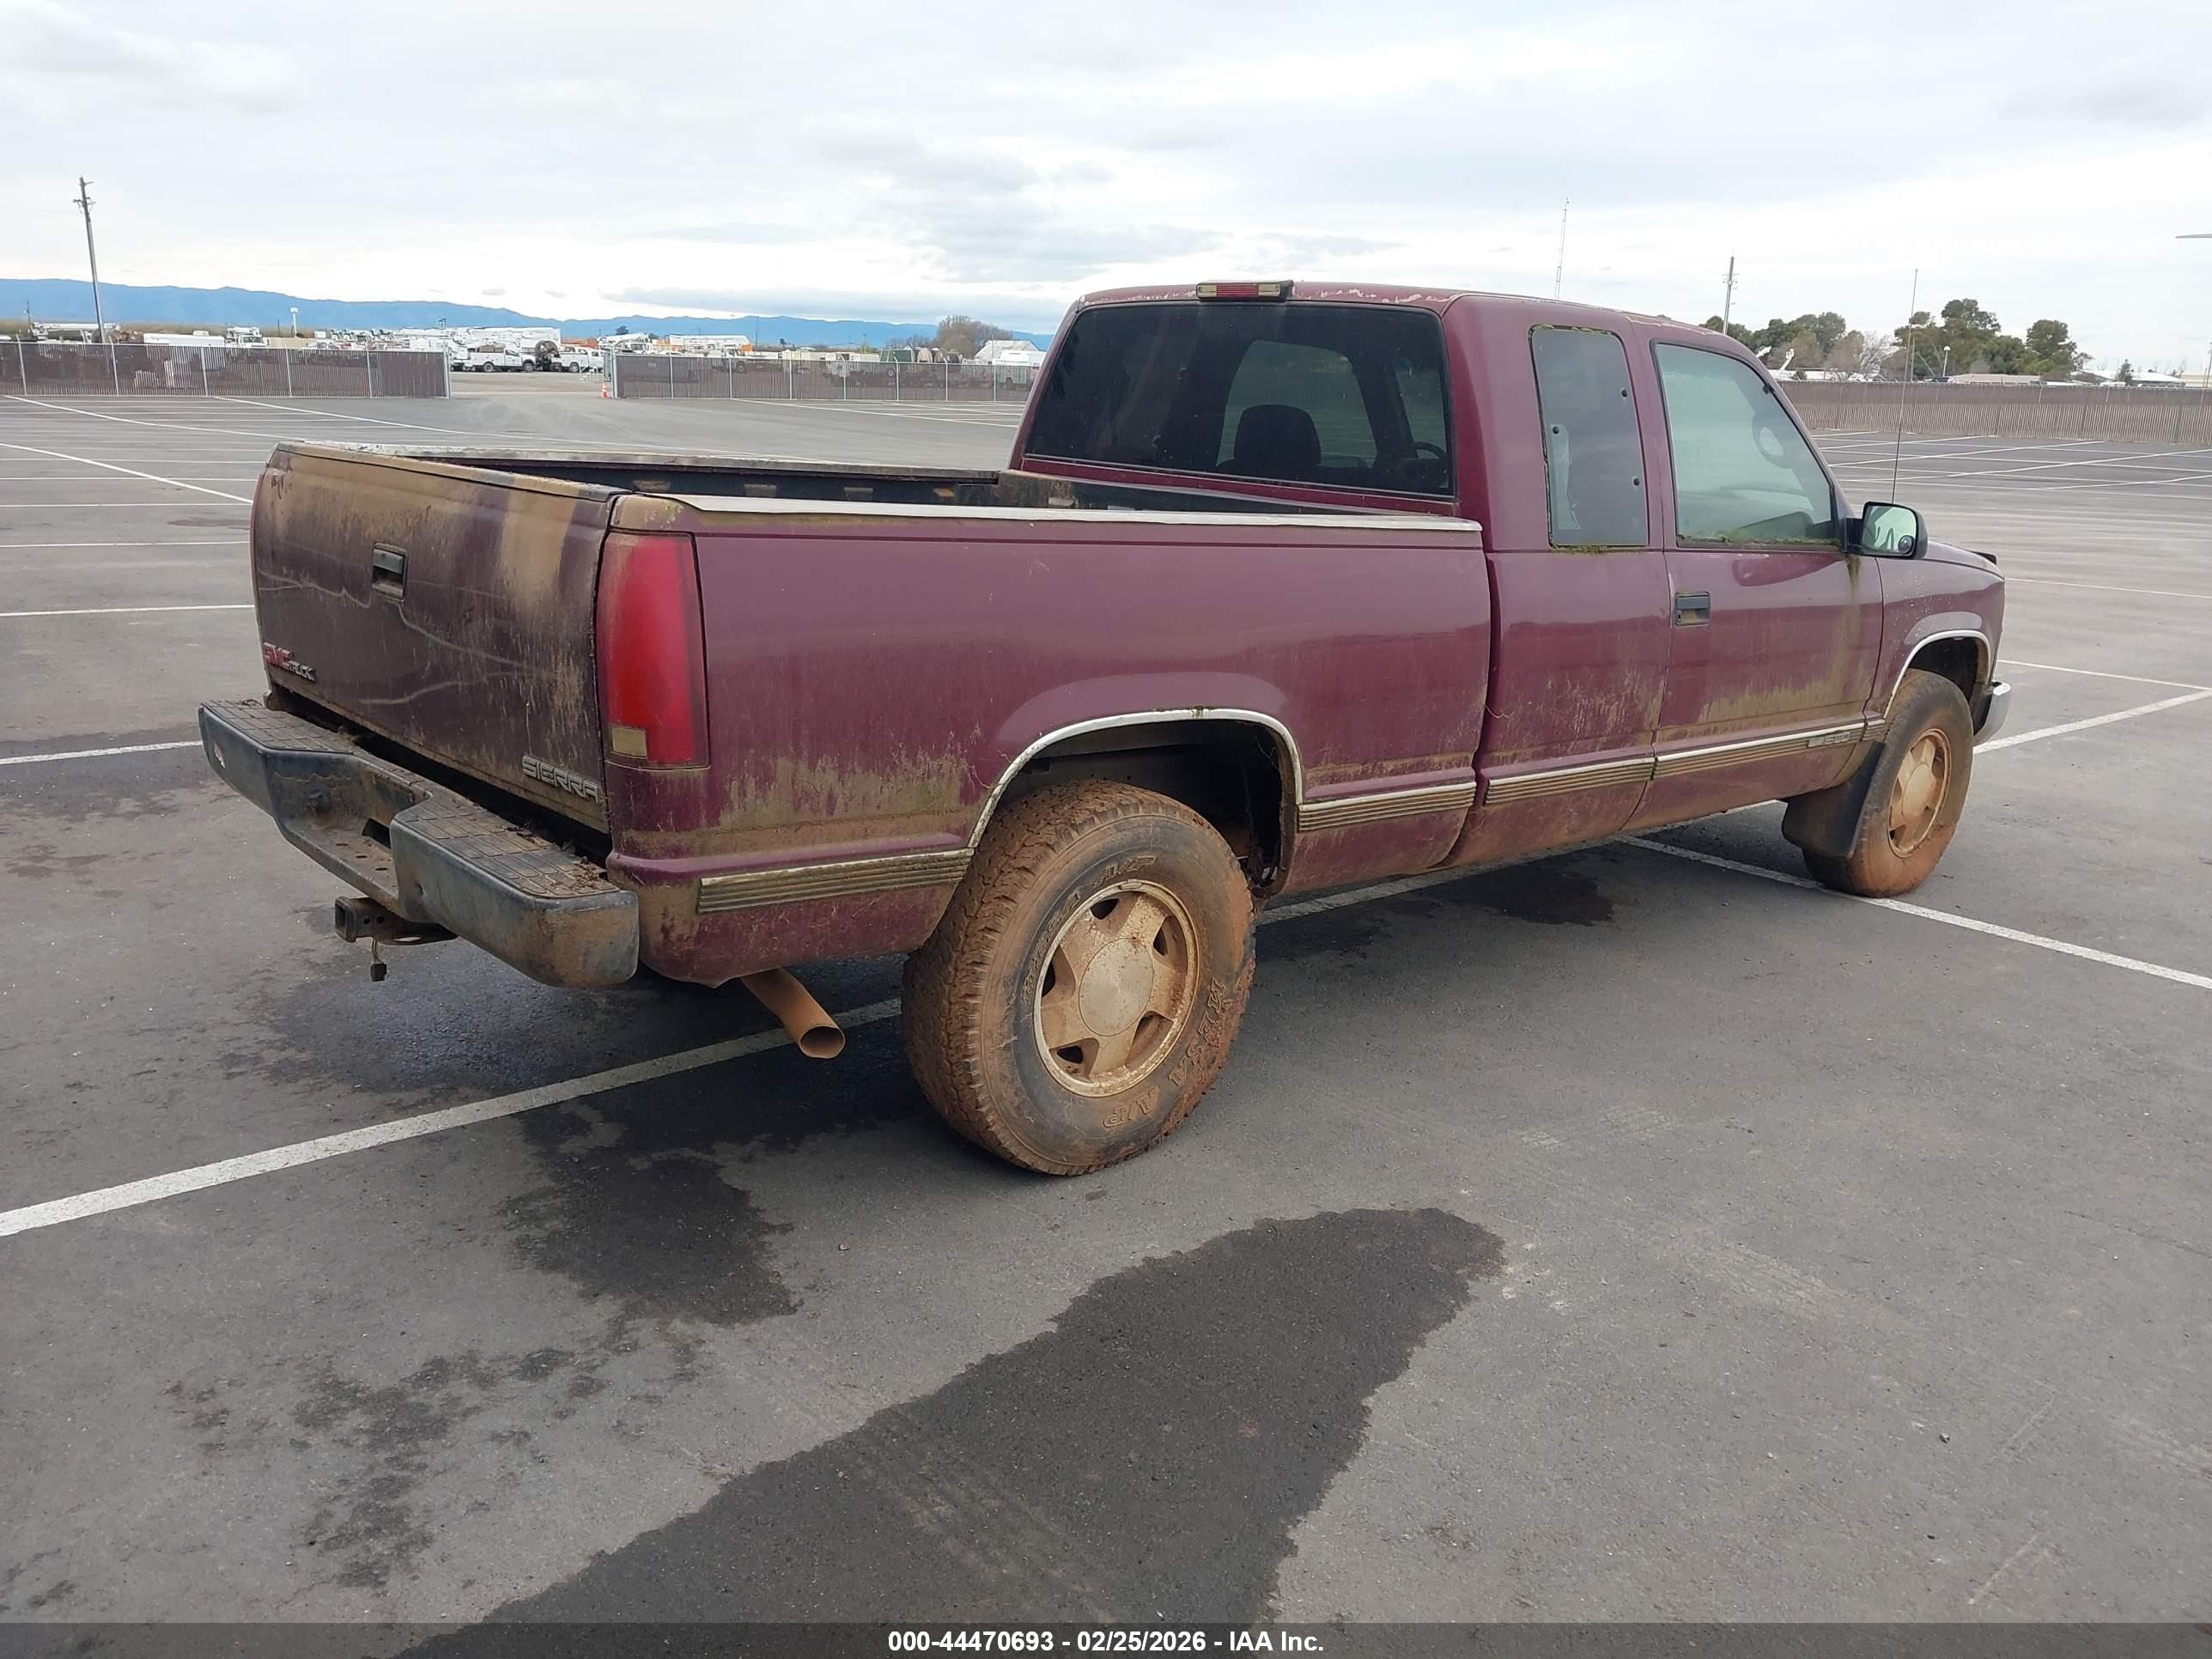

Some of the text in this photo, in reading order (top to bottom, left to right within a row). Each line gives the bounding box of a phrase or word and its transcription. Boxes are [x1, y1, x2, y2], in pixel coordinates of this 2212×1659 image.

[263, 641, 293, 671] GMC
[521, 755, 604, 805] SIERRA
[1103, 975, 1225, 1128] MESA A/P
